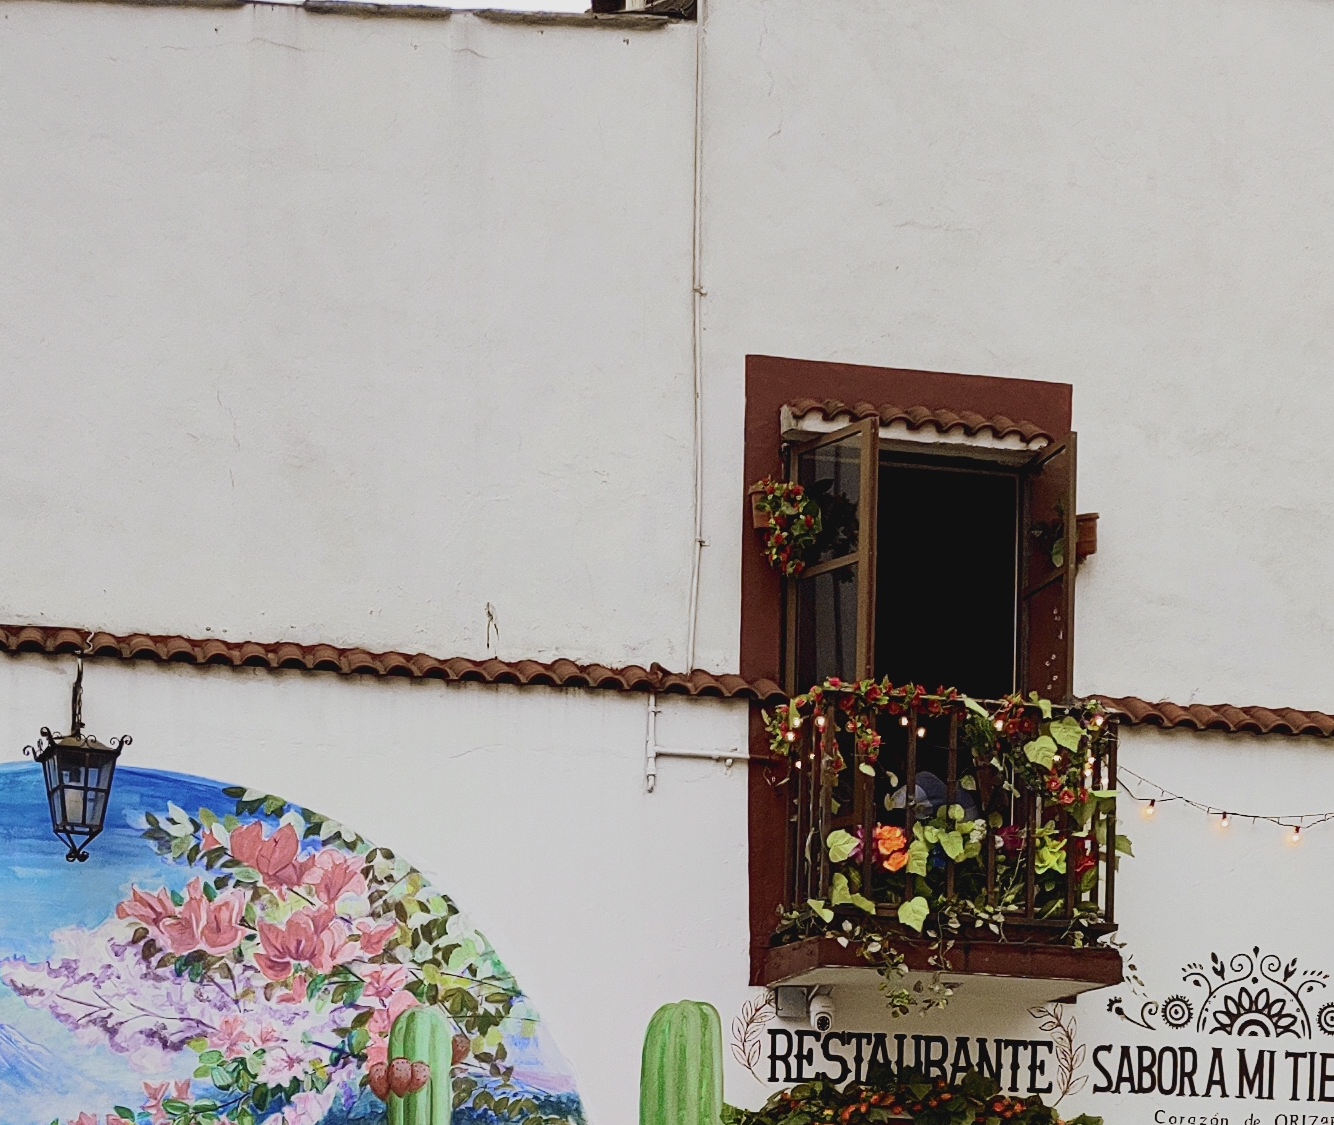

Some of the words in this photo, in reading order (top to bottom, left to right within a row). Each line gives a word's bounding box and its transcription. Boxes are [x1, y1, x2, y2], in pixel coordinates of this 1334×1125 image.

[1092, 1043, 1199, 1098] SABOR
[1202, 1047, 1230, 1098] A
[1235, 1048, 1275, 1101] MI
